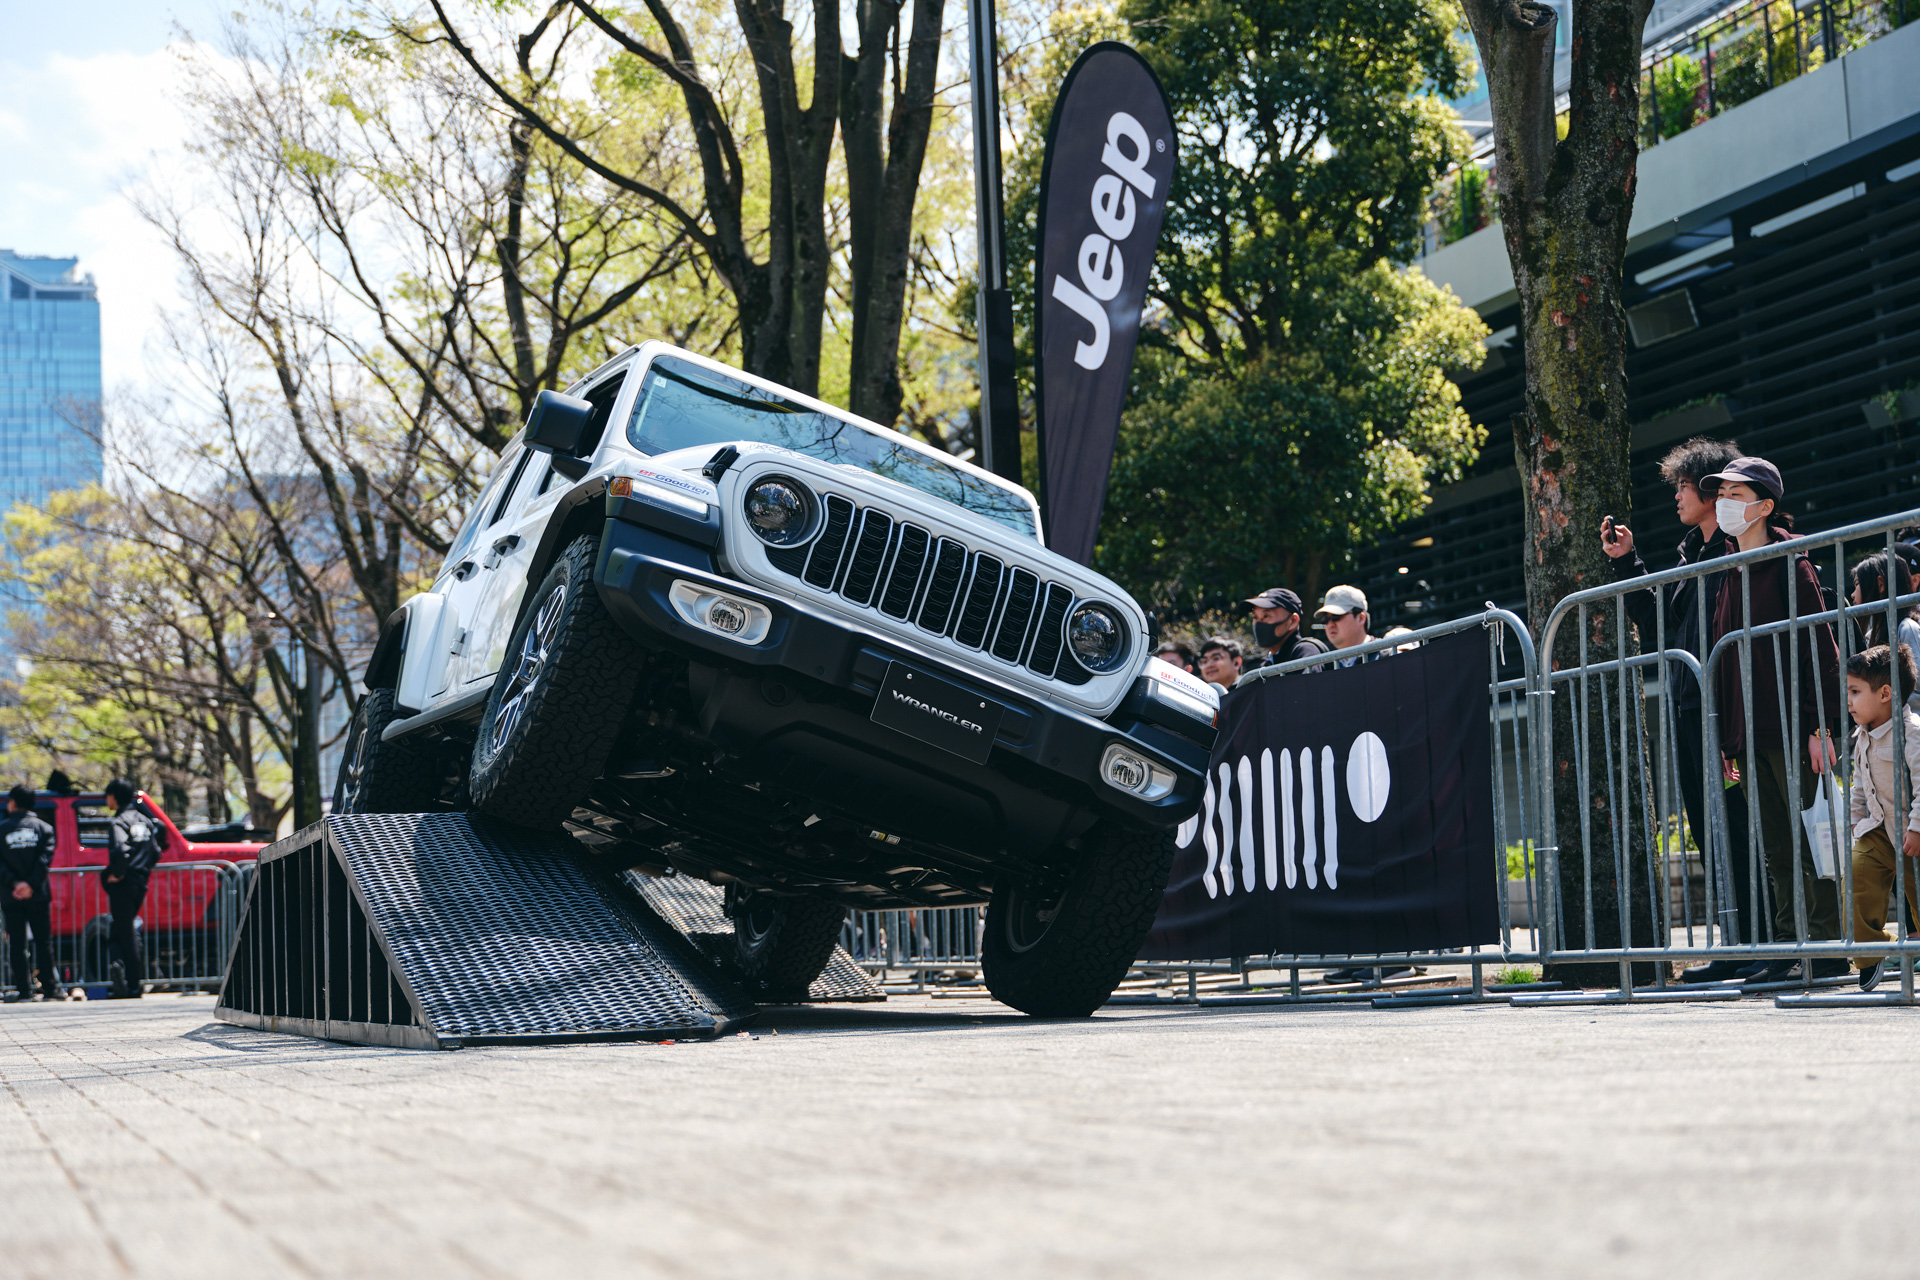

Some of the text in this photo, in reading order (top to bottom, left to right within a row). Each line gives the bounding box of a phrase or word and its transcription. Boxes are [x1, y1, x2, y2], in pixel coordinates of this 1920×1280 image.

[1052, 111, 1156, 370] Jeep
[637, 469, 710, 496] BFGoodrich
[1160, 671, 1215, 702] BFGoodrich
[892, 689, 983, 735] WRANGLER
